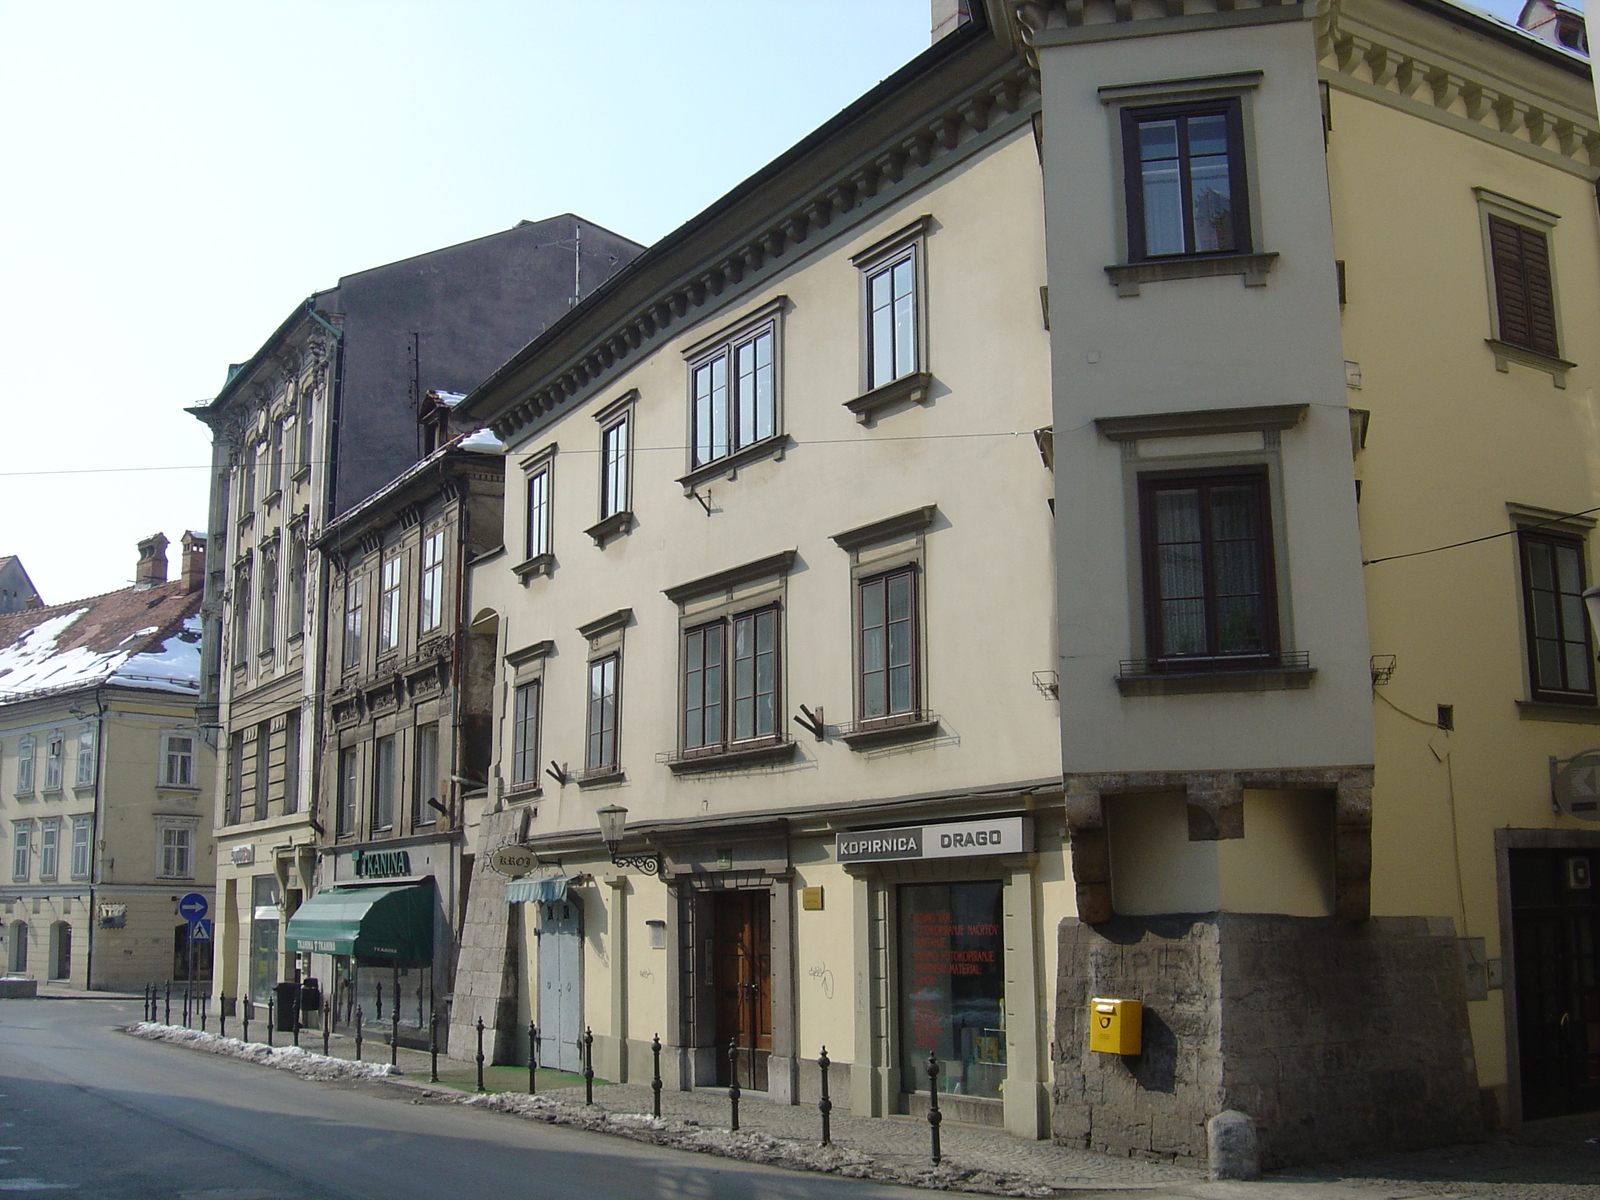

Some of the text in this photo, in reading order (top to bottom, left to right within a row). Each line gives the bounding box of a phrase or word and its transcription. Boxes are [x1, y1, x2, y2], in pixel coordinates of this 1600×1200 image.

[840, 830, 1002, 855] KOPIRNICA DRAGO
[362, 851, 405, 875] TKANINA
[499, 856, 531, 867] KROJ
[967, 922, 999, 935] NAČRTOV
[941, 951, 995, 961] FOTOKOPIRANJE
